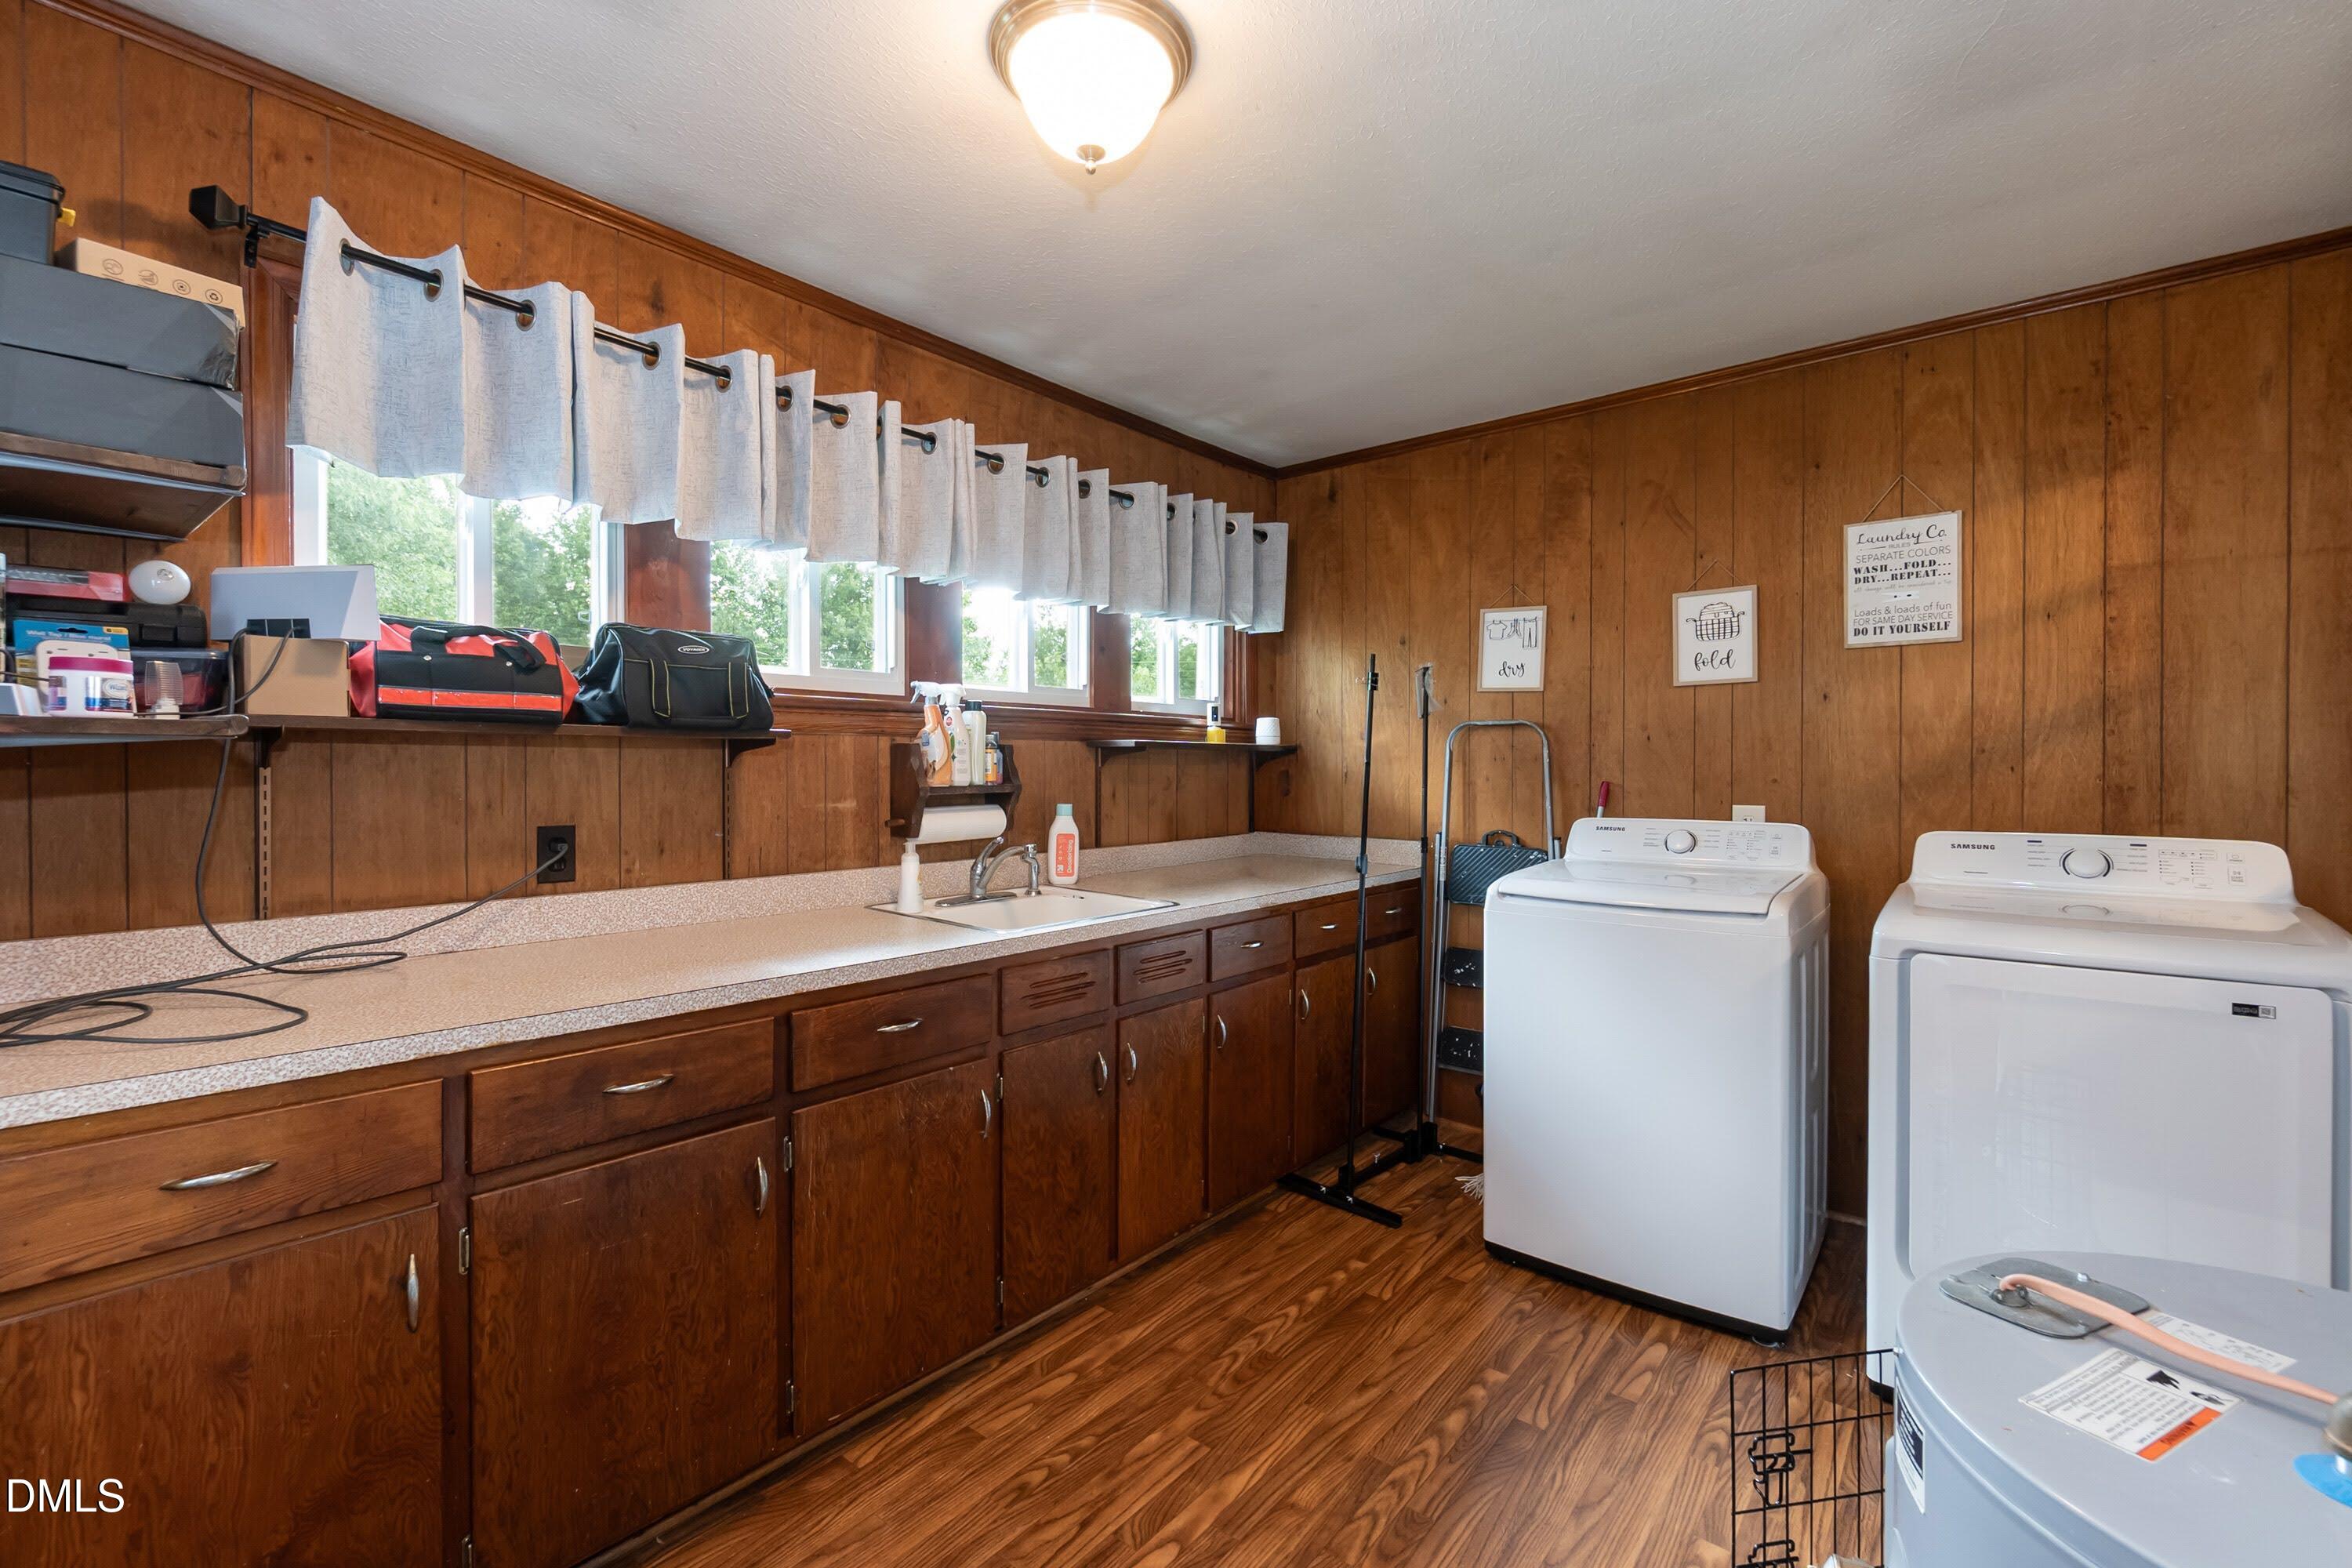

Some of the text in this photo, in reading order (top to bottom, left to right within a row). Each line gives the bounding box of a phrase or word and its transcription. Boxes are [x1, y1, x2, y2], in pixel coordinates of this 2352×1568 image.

[1857, 524, 1947, 544] Laundry Co.
[1857, 546, 1951, 564] SEPARATE COLORS
[1854, 601, 1951, 617] Loads & loads of fun
[1853, 612, 1953, 626] FOR SAME DAY SERVICE
[1853, 621, 1951, 637] DO IT YOURSELF
[1694, 649, 1736, 671] fold
[1498, 661, 1525, 678] dry
